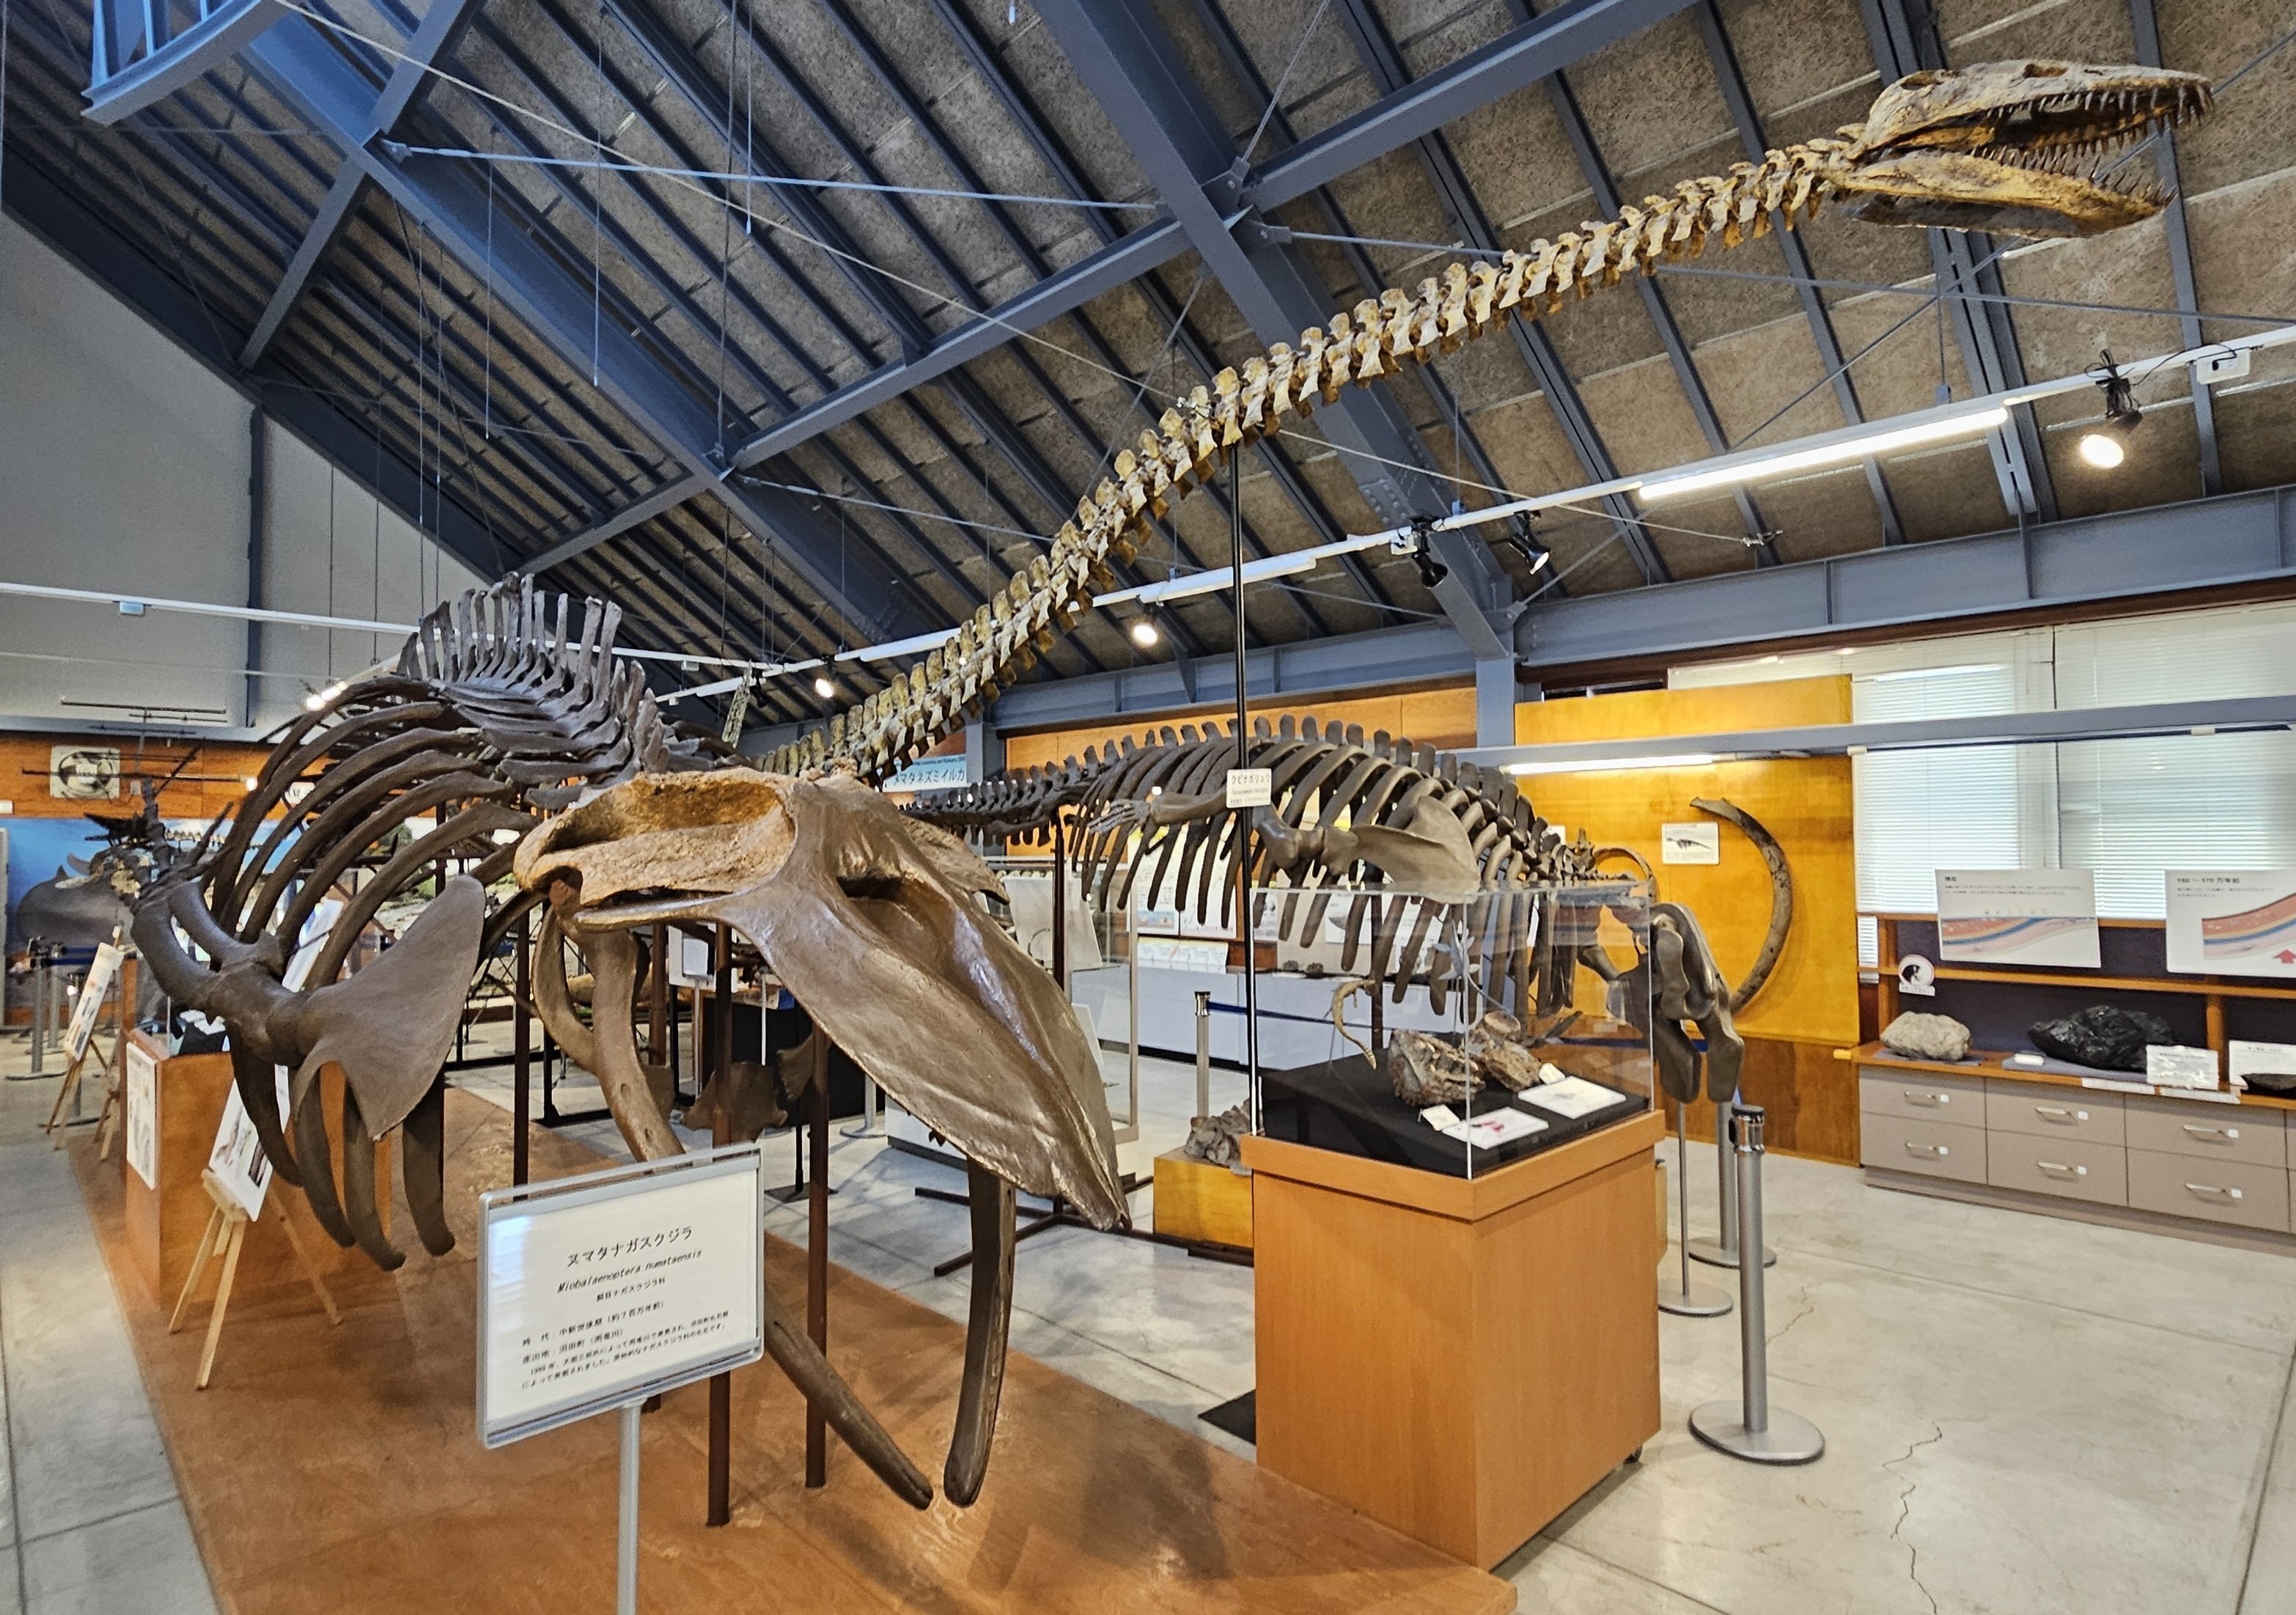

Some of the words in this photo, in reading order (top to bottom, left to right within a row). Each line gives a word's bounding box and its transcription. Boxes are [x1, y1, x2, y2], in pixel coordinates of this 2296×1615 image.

[567, 1226, 692, 1268] ヌマタナガスクジラ
[557, 1265, 641, 1293] Miobalaenoptera
[645, 1249, 702, 1271] numataensis
